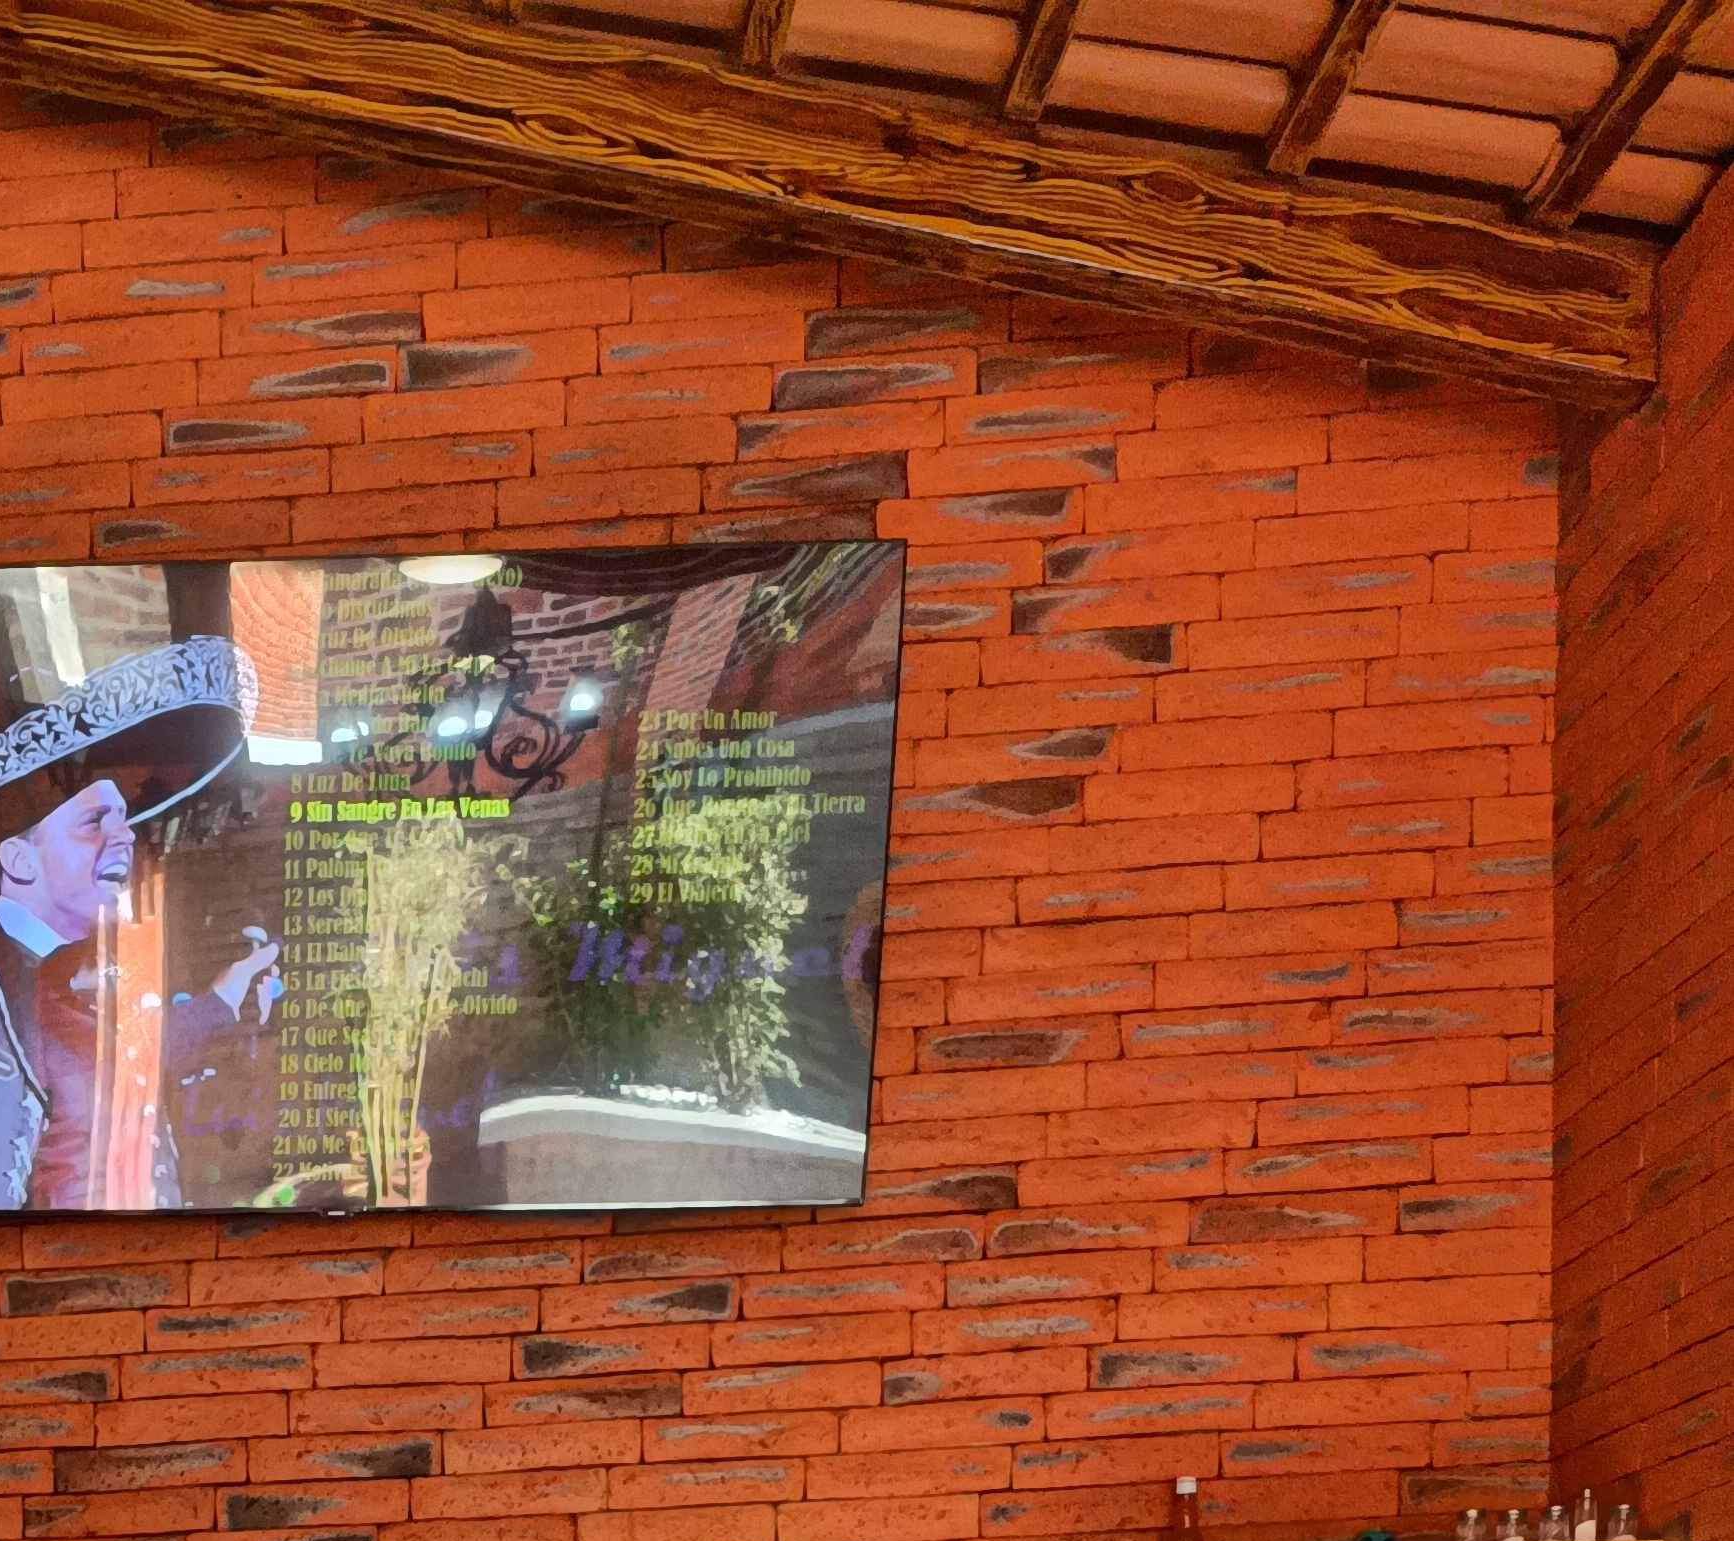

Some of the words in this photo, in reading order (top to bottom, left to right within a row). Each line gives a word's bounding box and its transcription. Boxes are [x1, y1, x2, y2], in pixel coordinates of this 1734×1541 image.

[666, 710, 698, 731] Por
[703, 708, 726, 730] Un
[730, 708, 778, 731] Amor
[420, 740, 477, 762] Bonito
[636, 738, 659, 761] 24
[719, 737, 752, 759] Una
[756, 736, 796, 758] Cosa
[291, 773, 303, 794] 8
[308, 772, 337, 793] Luz
[342, 771, 364, 793] De
[663, 767, 693, 792] Soy
[723, 764, 812, 788] Prohibido
[290, 801, 303, 823] 9
[307, 800, 333, 822] Sin
[337, 799, 397, 824] Sangre
[400, 798, 422, 820] En
[427, 797, 454, 819] Las
[459, 796, 510, 818] Venas
[633, 797, 657, 819] 26
[812, 792, 866, 815] Tierra
[284, 830, 304, 851] 10
[309, 829, 340, 850] Por
[284, 859, 300, 880] 11
[630, 854, 654, 876] 28
[284, 887, 303, 907] 12
[308, 886, 334, 907] Los
[629, 882, 654, 904] 29
[657, 882, 674, 903] El
[283, 915, 303, 936] 13
[282, 943, 300, 963] 14
[307, 942, 322, 963] El
[283, 970, 300, 991] 15
[306, 970, 325, 991] La
[281, 999, 300, 1019] 16
[305, 998, 328, 1019] De
[332, 997, 366, 1019] Que
[463, 994, 518, 1016] Olvido
[281, 1026, 300, 1047] 17
[304, 1026, 338, 1048] Que
[280, 1054, 299, 1074] 18
[303, 1053, 344, 1074] Cielo
[280, 1081, 299, 1101] 19
[303, 1080, 357, 1102] Entreg
[278, 1108, 301, 1128] 20
[306, 1107, 322, 1128] El
[325, 1107, 364, 1128] Siete
[273, 1134, 291, 1156] 21
[296, 1134, 317, 1156] No
[322, 1133, 345, 1155] Me
[272, 1161, 294, 1182] 22
